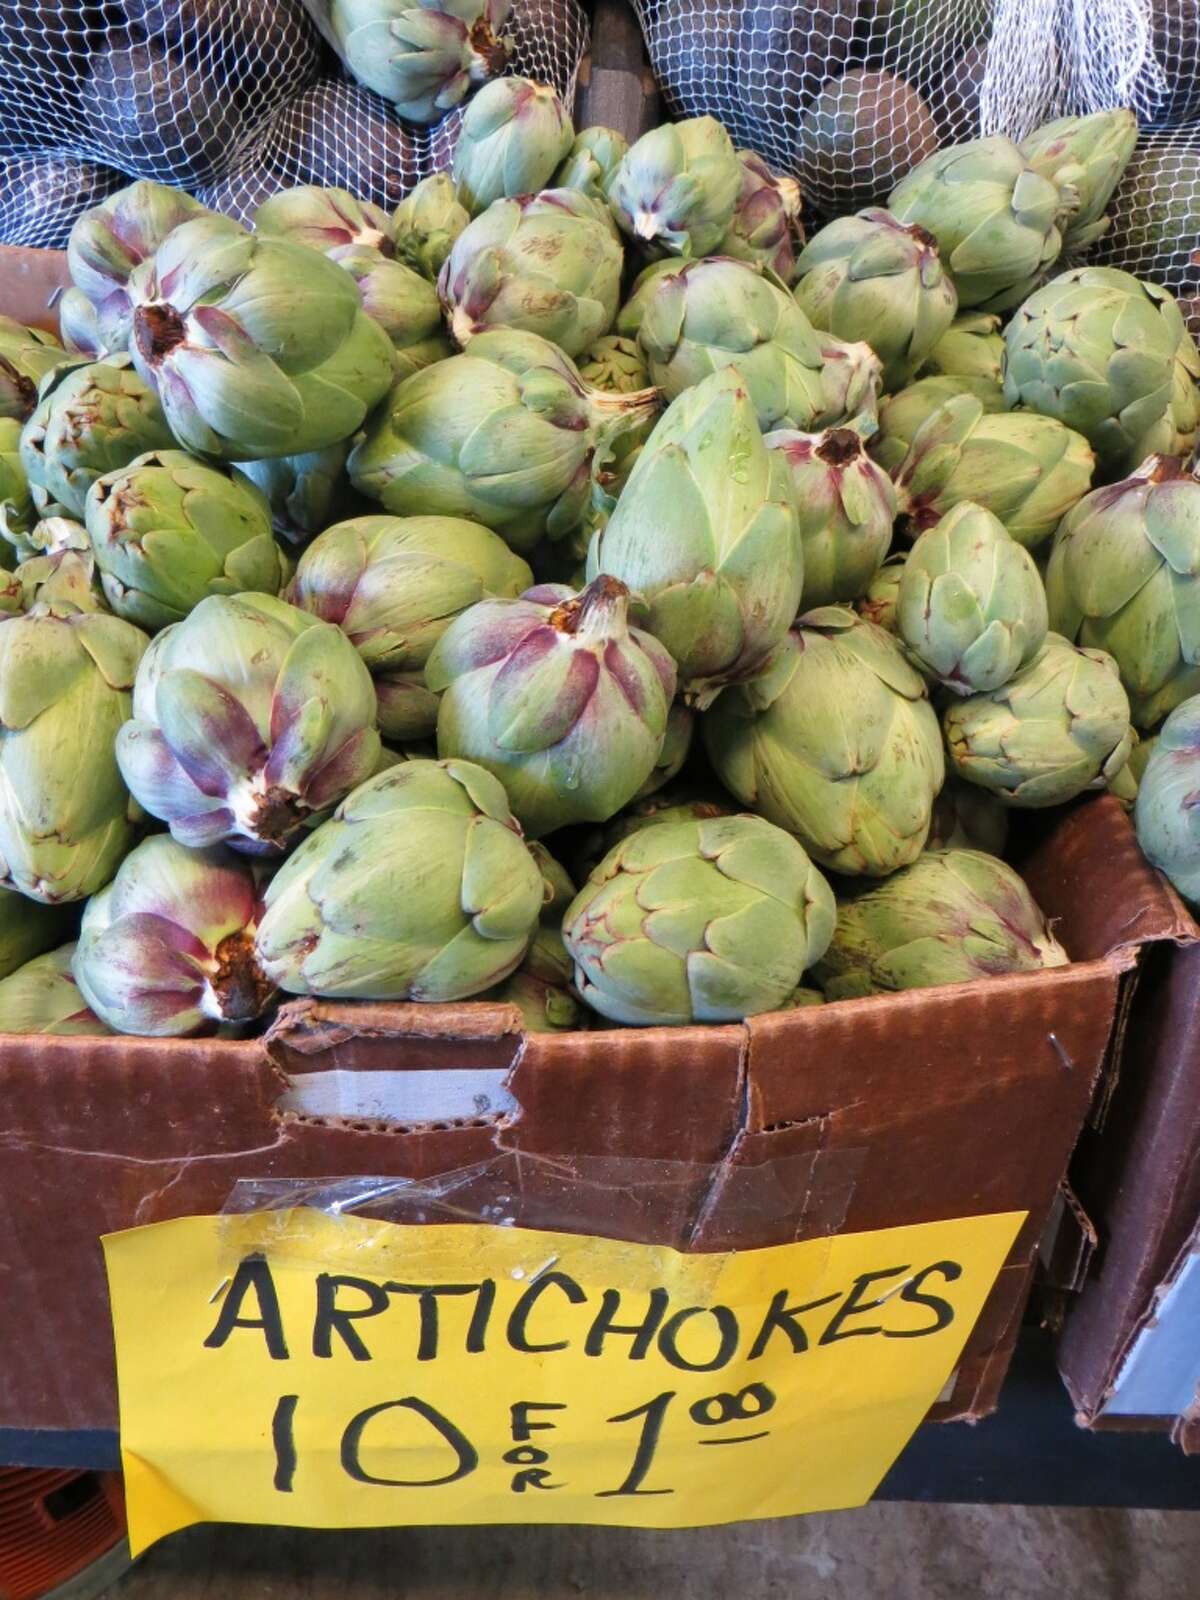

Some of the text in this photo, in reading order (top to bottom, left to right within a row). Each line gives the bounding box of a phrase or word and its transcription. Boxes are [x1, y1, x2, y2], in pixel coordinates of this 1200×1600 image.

[204, 1252, 963, 1373] ARTICHOKES
[273, 1394, 479, 1492] 10
[502, 1401, 567, 1494] FOR
